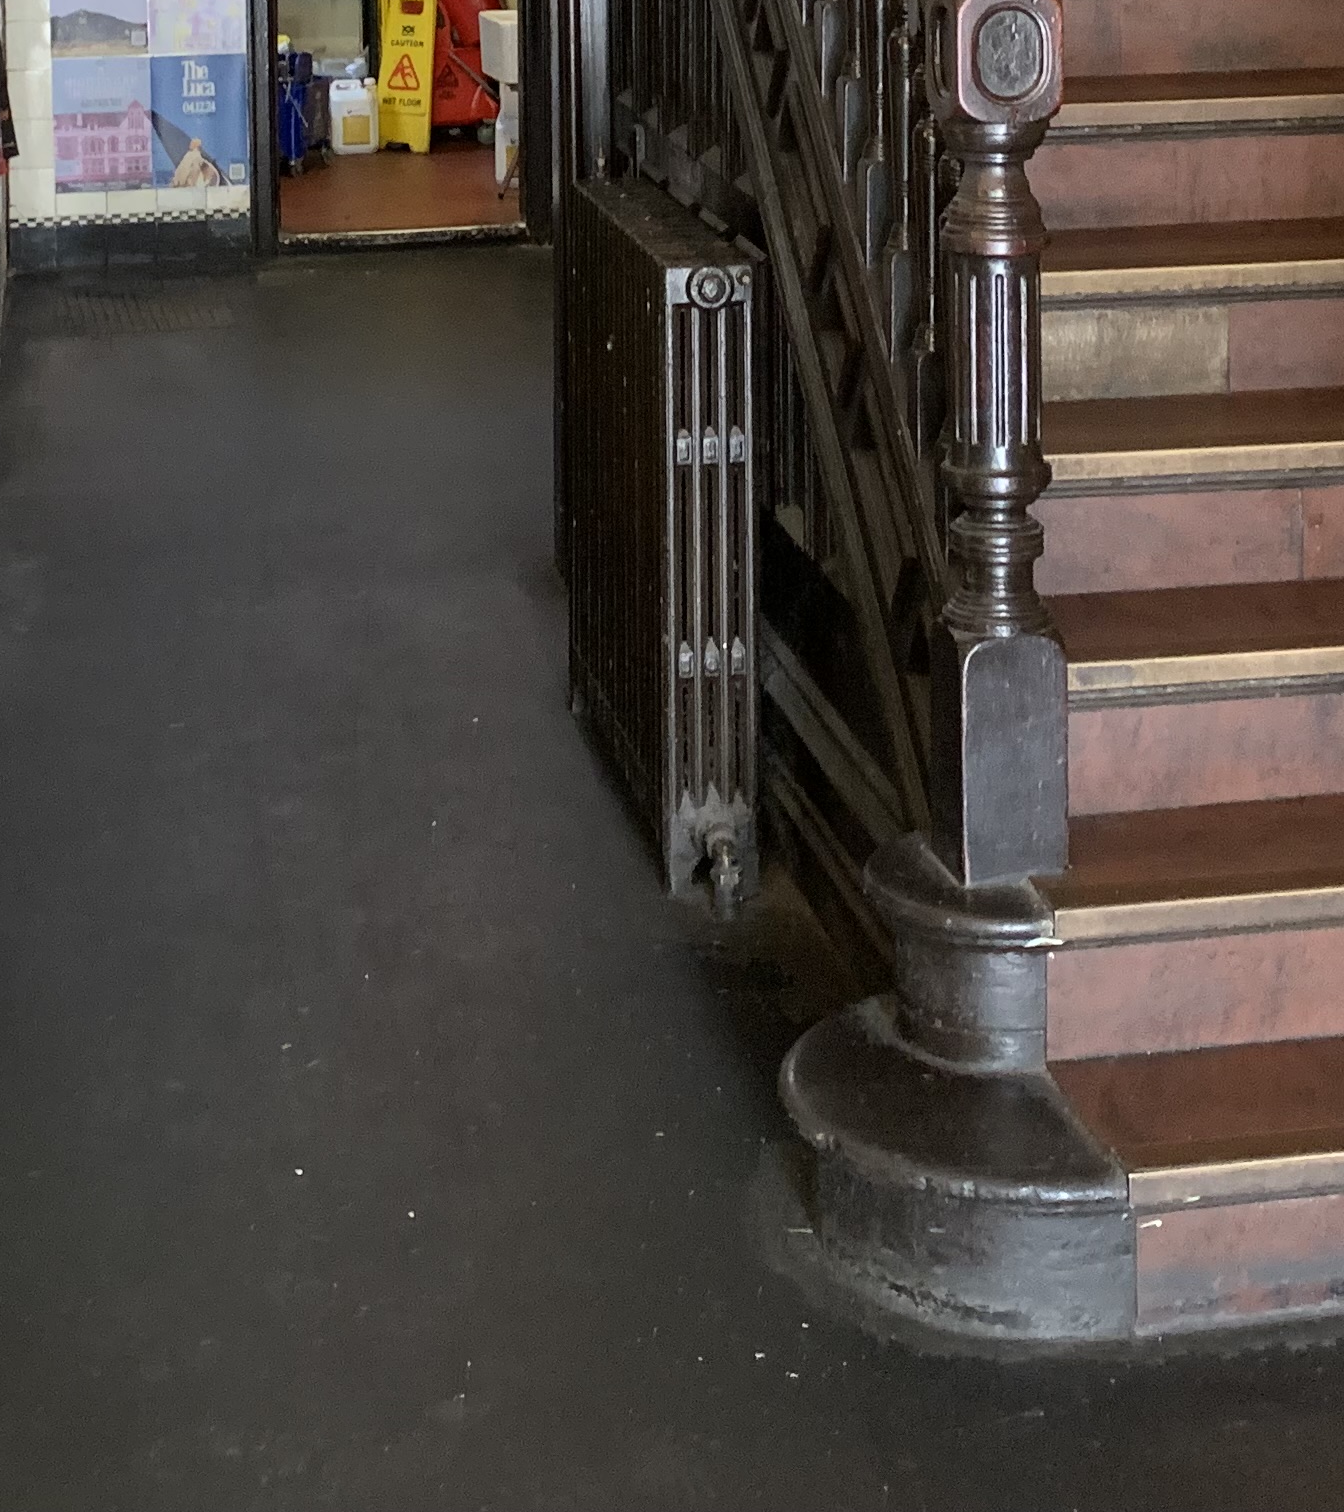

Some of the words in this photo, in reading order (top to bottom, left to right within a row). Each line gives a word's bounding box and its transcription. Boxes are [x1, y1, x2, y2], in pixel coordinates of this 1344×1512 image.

[181, 60, 208, 80] The
[182, 79, 215, 97] Luca
[382, 97, 396, 105] WET
[399, 98, 421, 106] FLOOR
